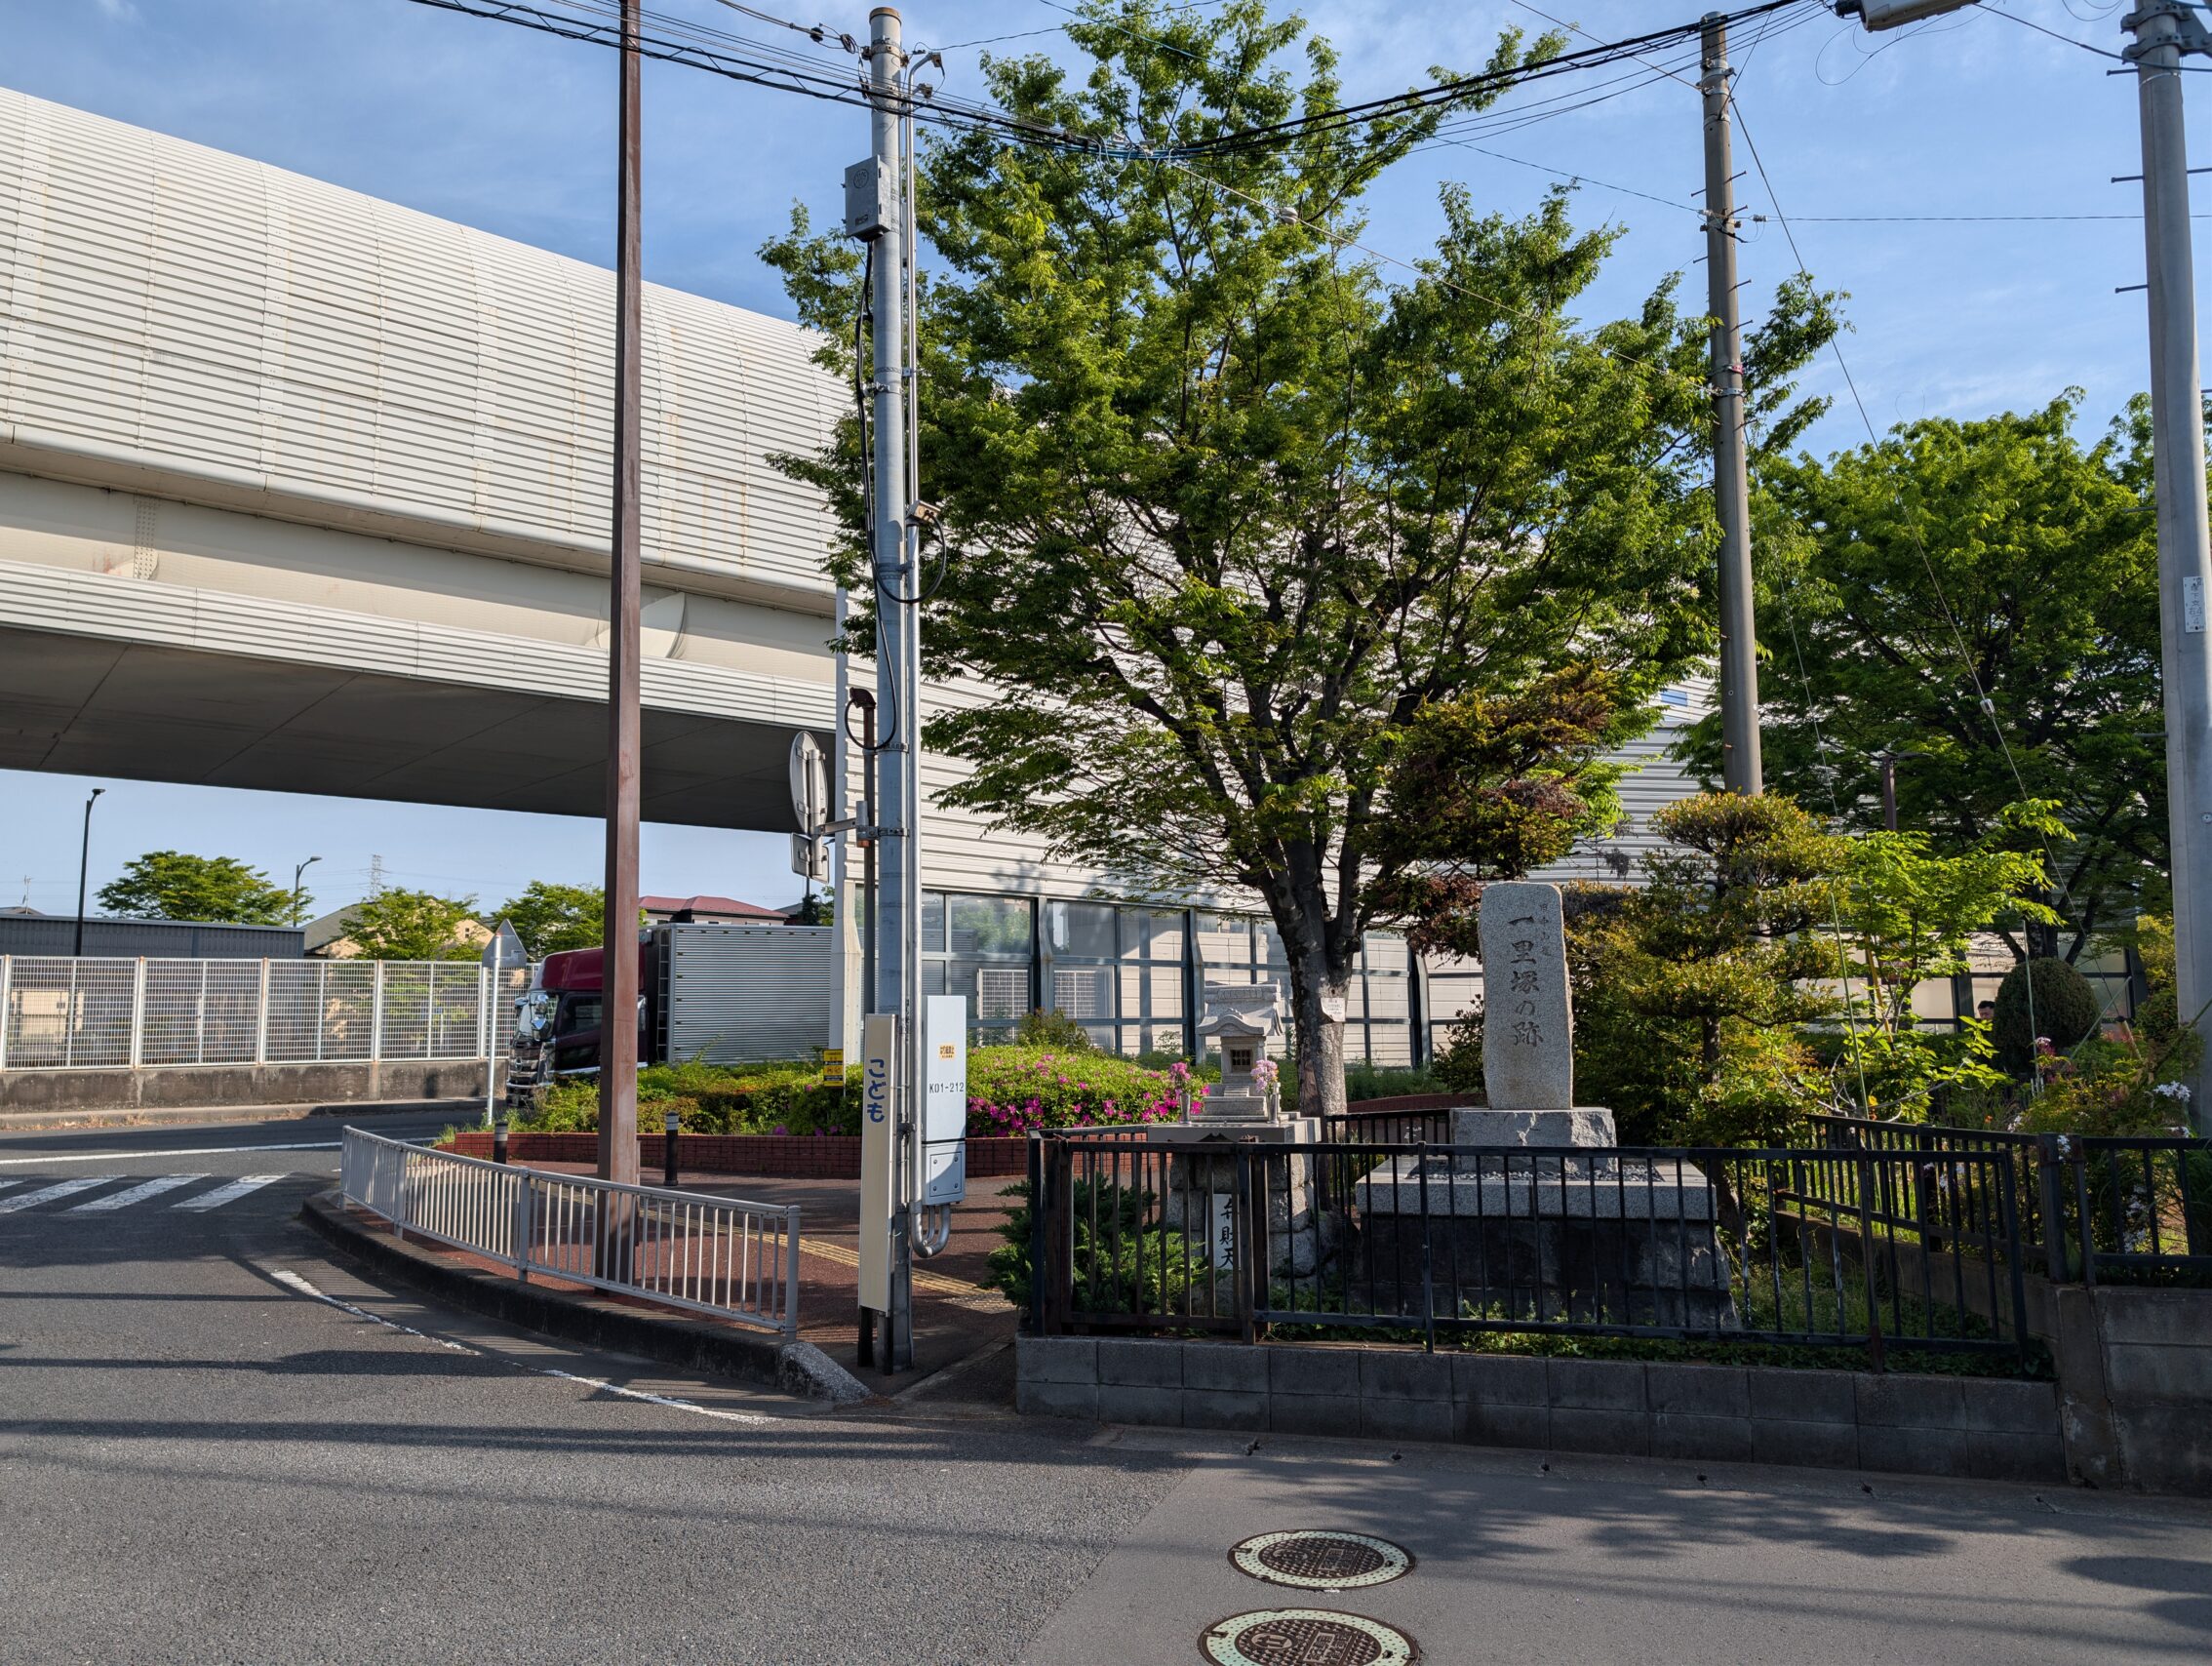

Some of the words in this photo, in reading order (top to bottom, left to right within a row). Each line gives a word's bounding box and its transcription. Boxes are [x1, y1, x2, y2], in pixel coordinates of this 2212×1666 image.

[1508, 915, 1544, 1048] 一里塚の跡
[866, 1058, 888, 1124] こども
[928, 1083, 965, 1093] K01-212
